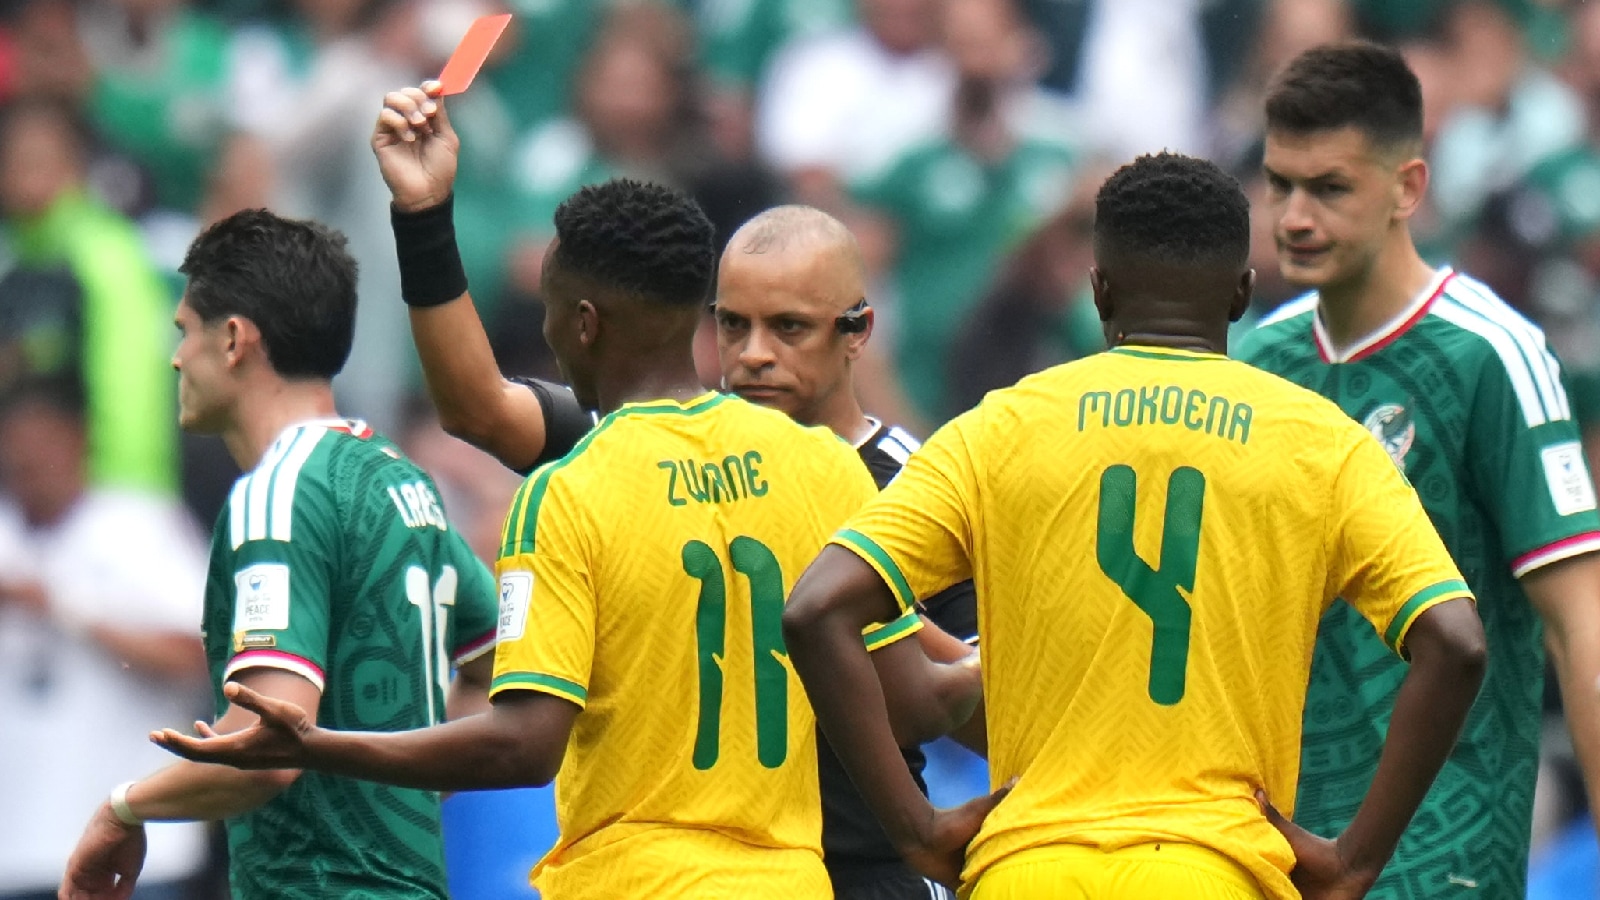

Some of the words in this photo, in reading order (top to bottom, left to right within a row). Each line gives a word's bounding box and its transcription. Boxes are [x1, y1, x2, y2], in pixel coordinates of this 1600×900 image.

[658, 450, 769, 506] ZWANE
[1078, 387, 1253, 443] MOKOENA
[682, 536, 787, 770] 11
[1097, 465, 1206, 706] 4
